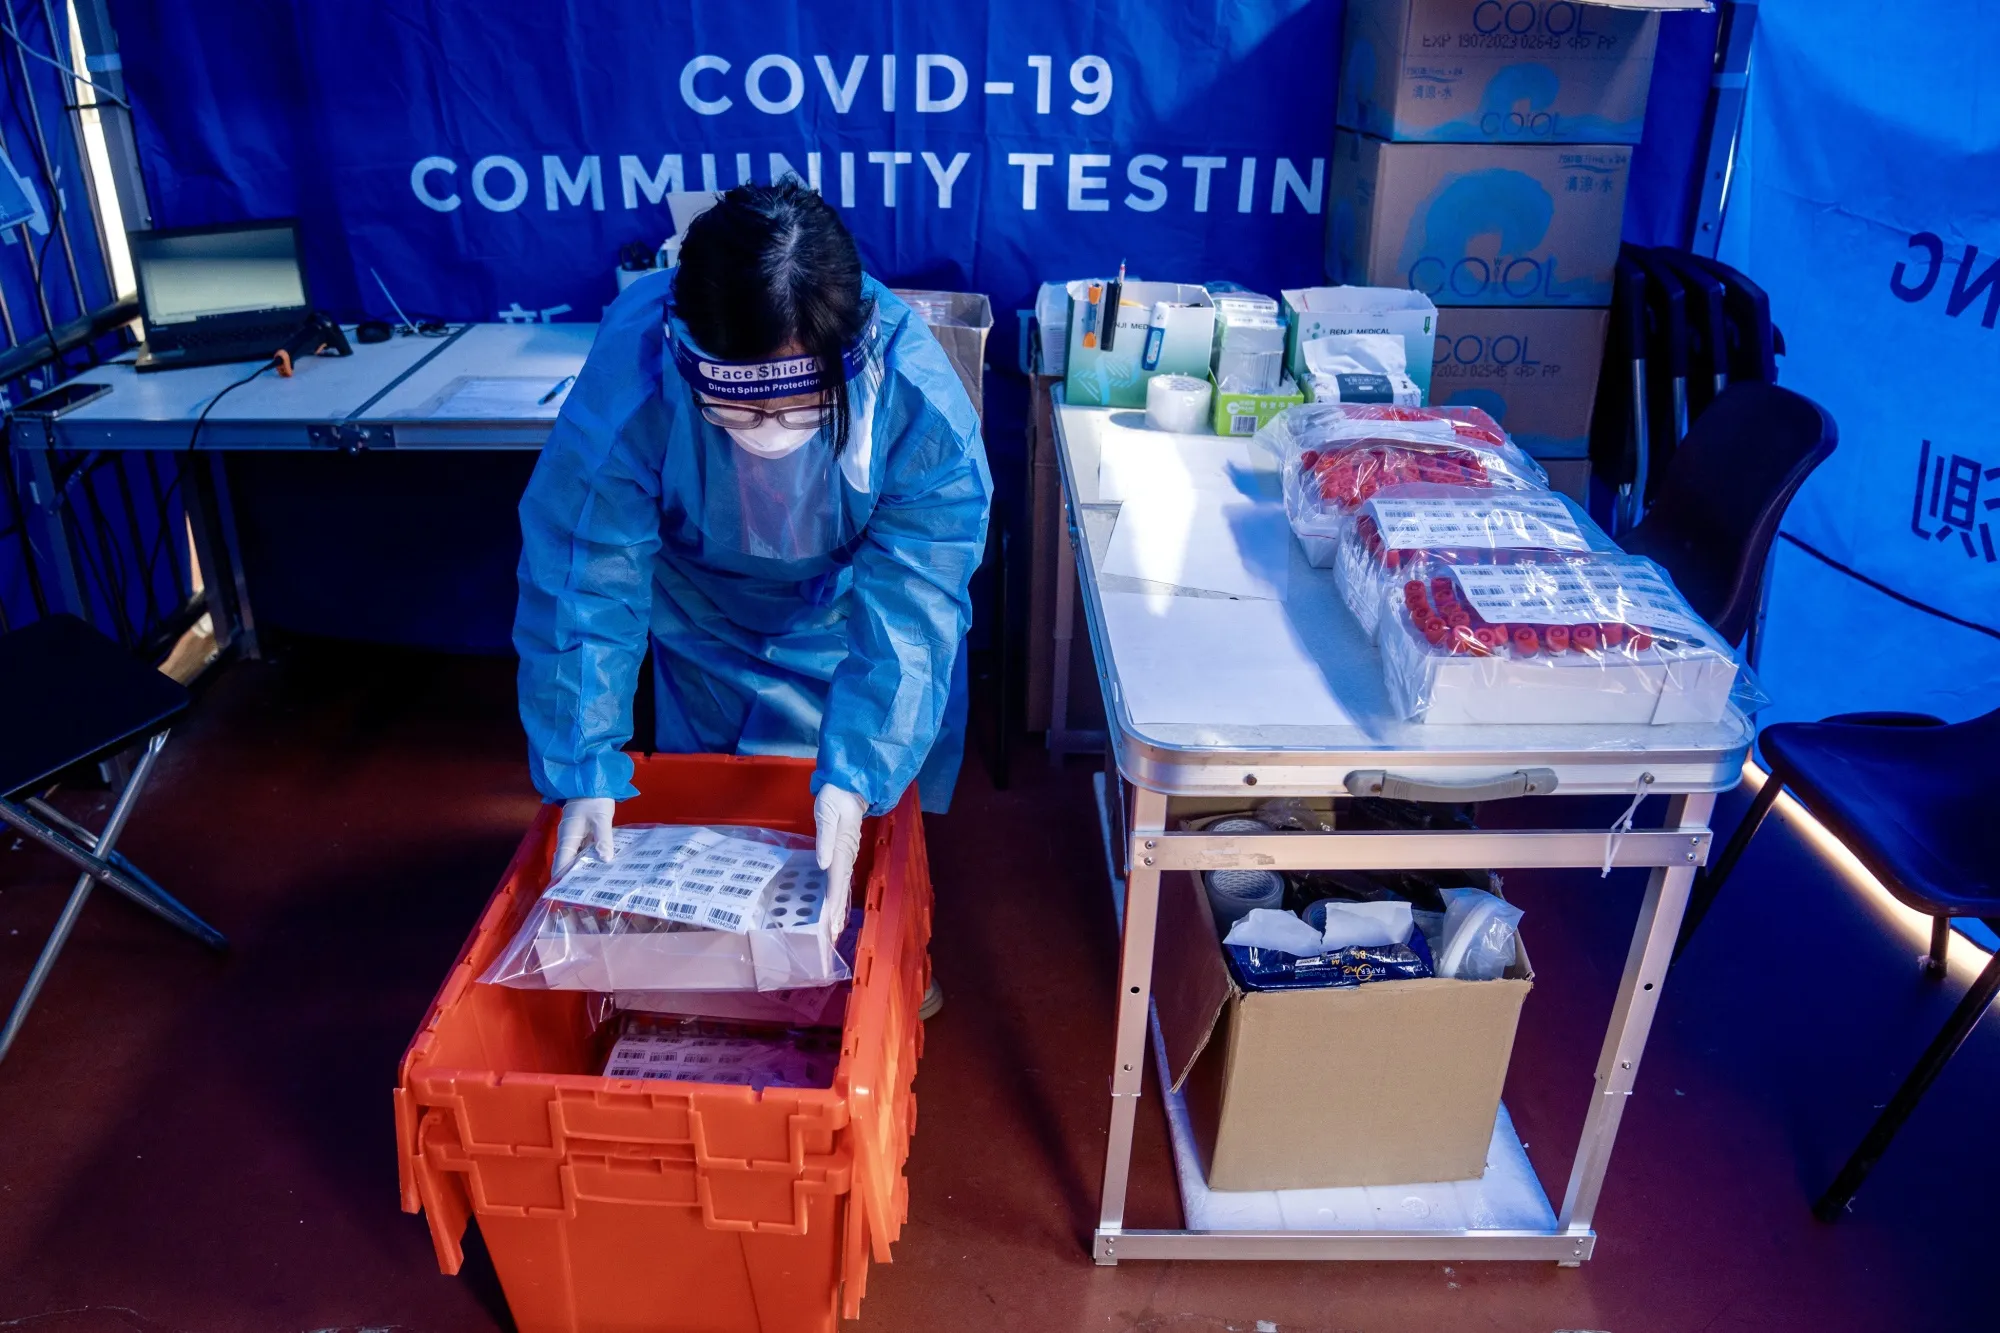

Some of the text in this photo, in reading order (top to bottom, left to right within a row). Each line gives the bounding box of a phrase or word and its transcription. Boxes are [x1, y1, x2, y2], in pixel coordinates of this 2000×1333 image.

[679, 53, 1114, 115] COVID-19
[1007, 153, 1325, 214] TESTIN
[1356, 327, 1391, 335] MEDICAL
[711, 358, 815, 380] Face Shield
[708, 378, 820, 394] Direct Splash Protection
